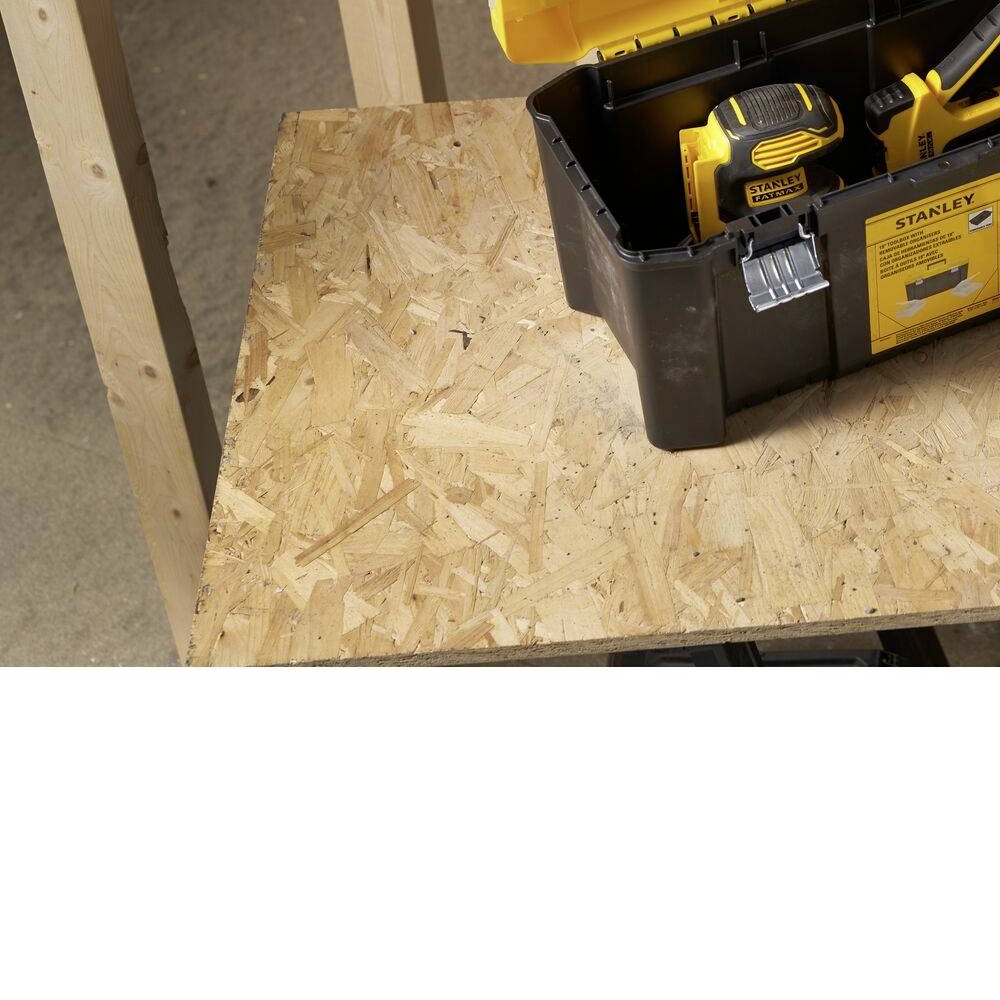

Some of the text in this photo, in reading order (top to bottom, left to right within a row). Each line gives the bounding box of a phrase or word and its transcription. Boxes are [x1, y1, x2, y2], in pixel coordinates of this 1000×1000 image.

[918, 135, 928, 160] NLEY
[749, 173, 801, 194] STANLEY
[754, 184, 802, 203] FATMAX
[895, 193, 975, 230] STANLEY
[879, 242, 908, 255] REMOVABLE
[887, 236, 910, 248] TOOLBOX
